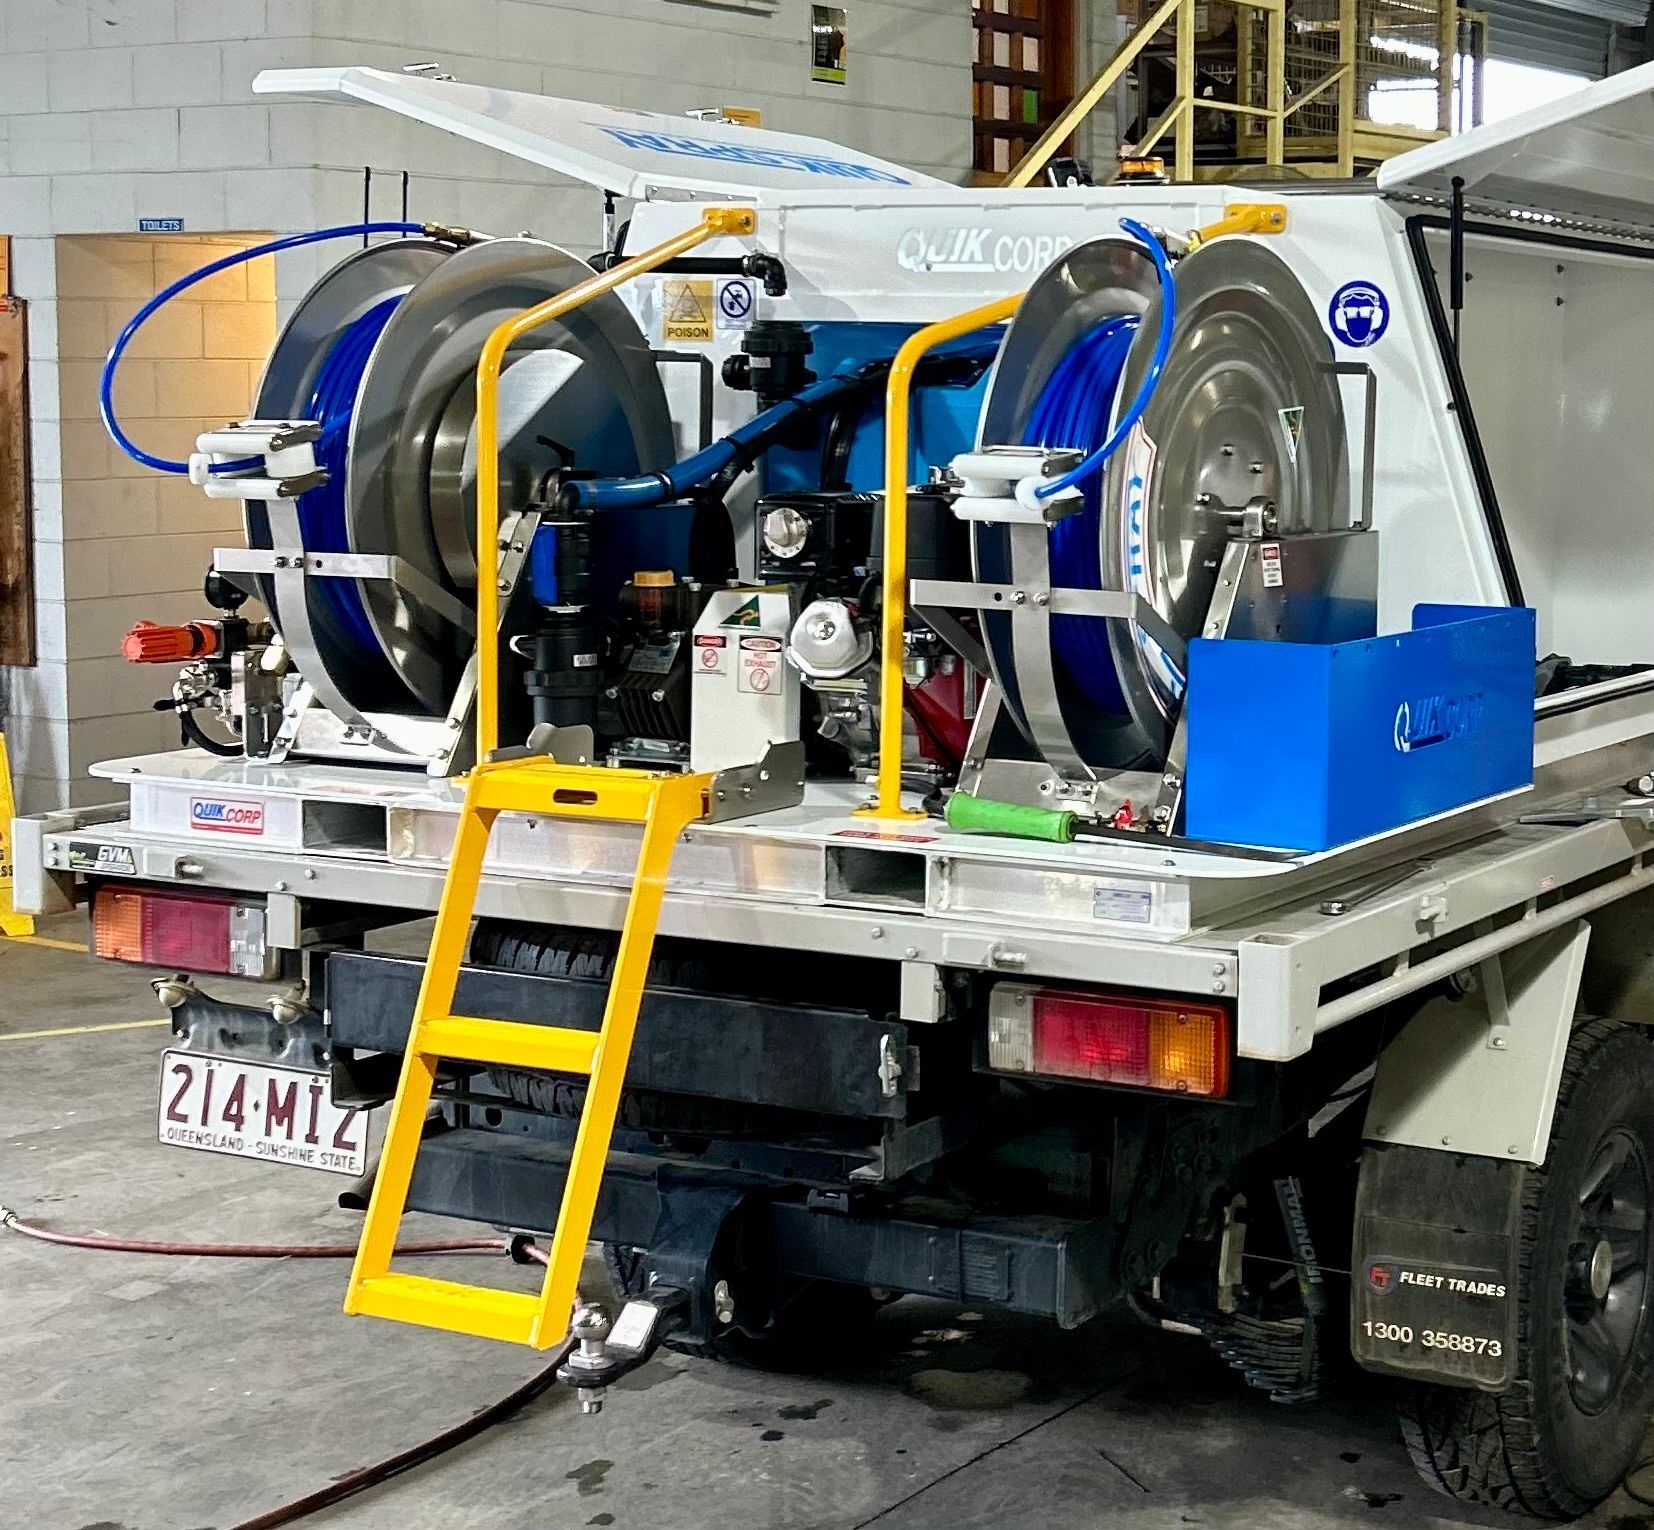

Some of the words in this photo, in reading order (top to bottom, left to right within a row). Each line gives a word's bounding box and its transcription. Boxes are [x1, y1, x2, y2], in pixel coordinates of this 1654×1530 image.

[141, 220, 180, 231] TOILETS
[897, 227, 994, 273] QUIK
[667, 327, 709, 338] POISON
[193, 802, 227, 821] QUIK
[226, 808, 261, 824] CORP
[97, 845, 130, 864] GVM
[166, 1127, 245, 1151] QUEENSLAND
[255, 1141, 316, 1164] SUNSHINE
[320, 1152, 359, 1171] STATE
[1399, 1271, 1445, 1289] FLEET
[1448, 1277, 1507, 1298] TRADES
[1362, 1320, 1415, 1344] 1300
[1421, 1329, 1503, 1358] 358873
